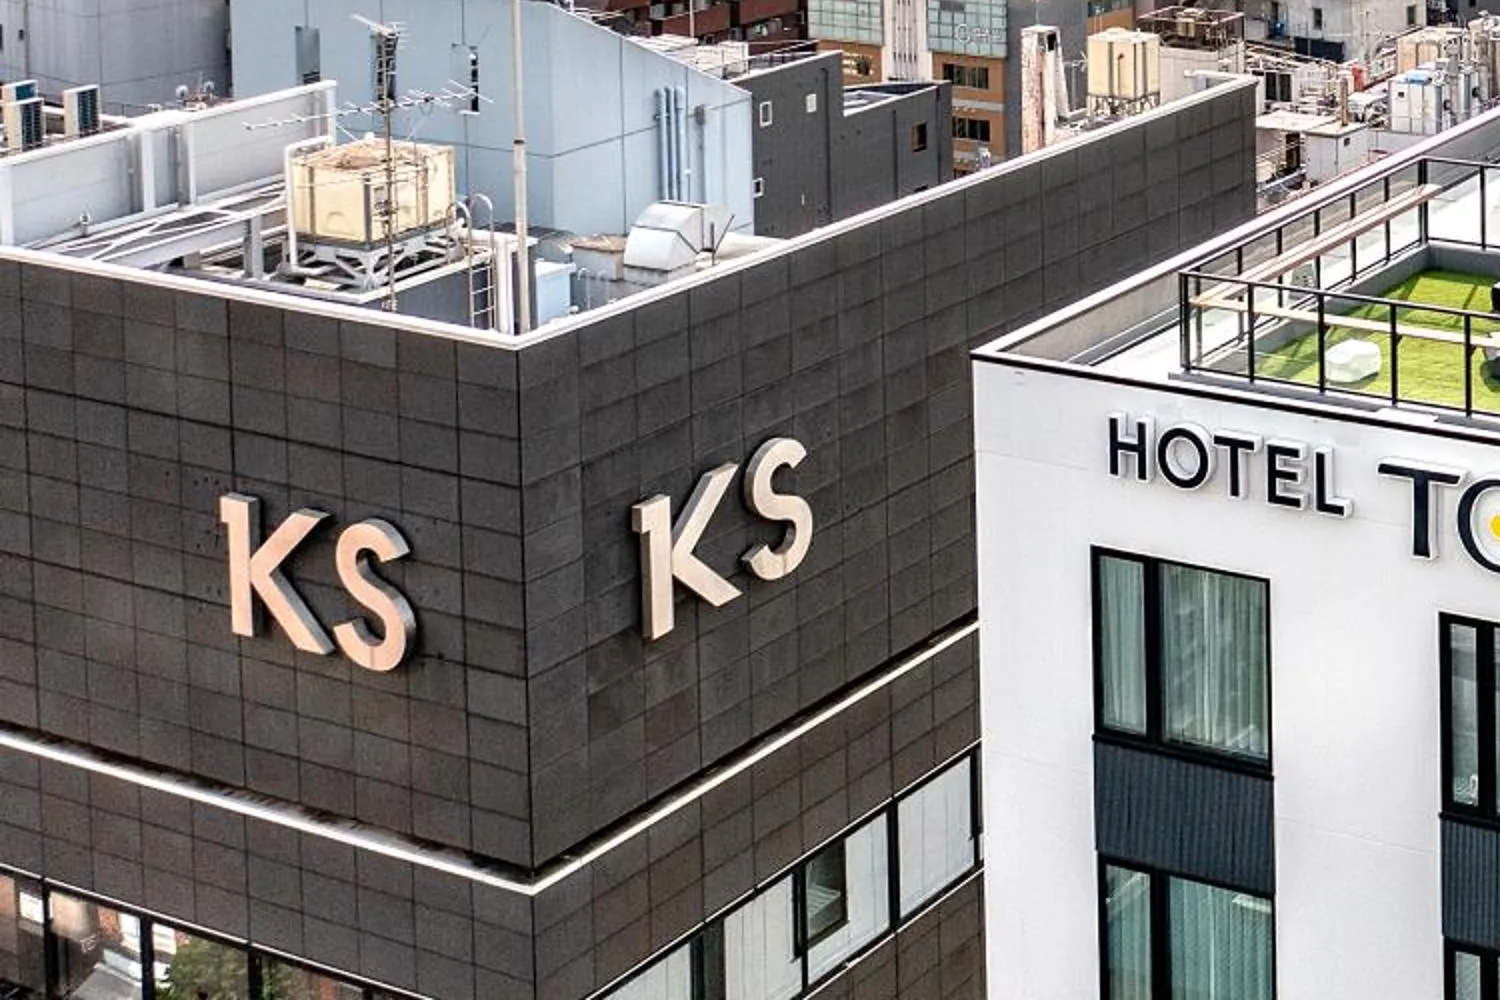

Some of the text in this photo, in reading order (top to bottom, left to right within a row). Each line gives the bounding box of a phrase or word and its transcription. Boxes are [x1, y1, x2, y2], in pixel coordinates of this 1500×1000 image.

[632, 437, 814, 640] KS
[1107, 411, 1352, 518] HOTEL
[219, 491, 417, 672] KS
